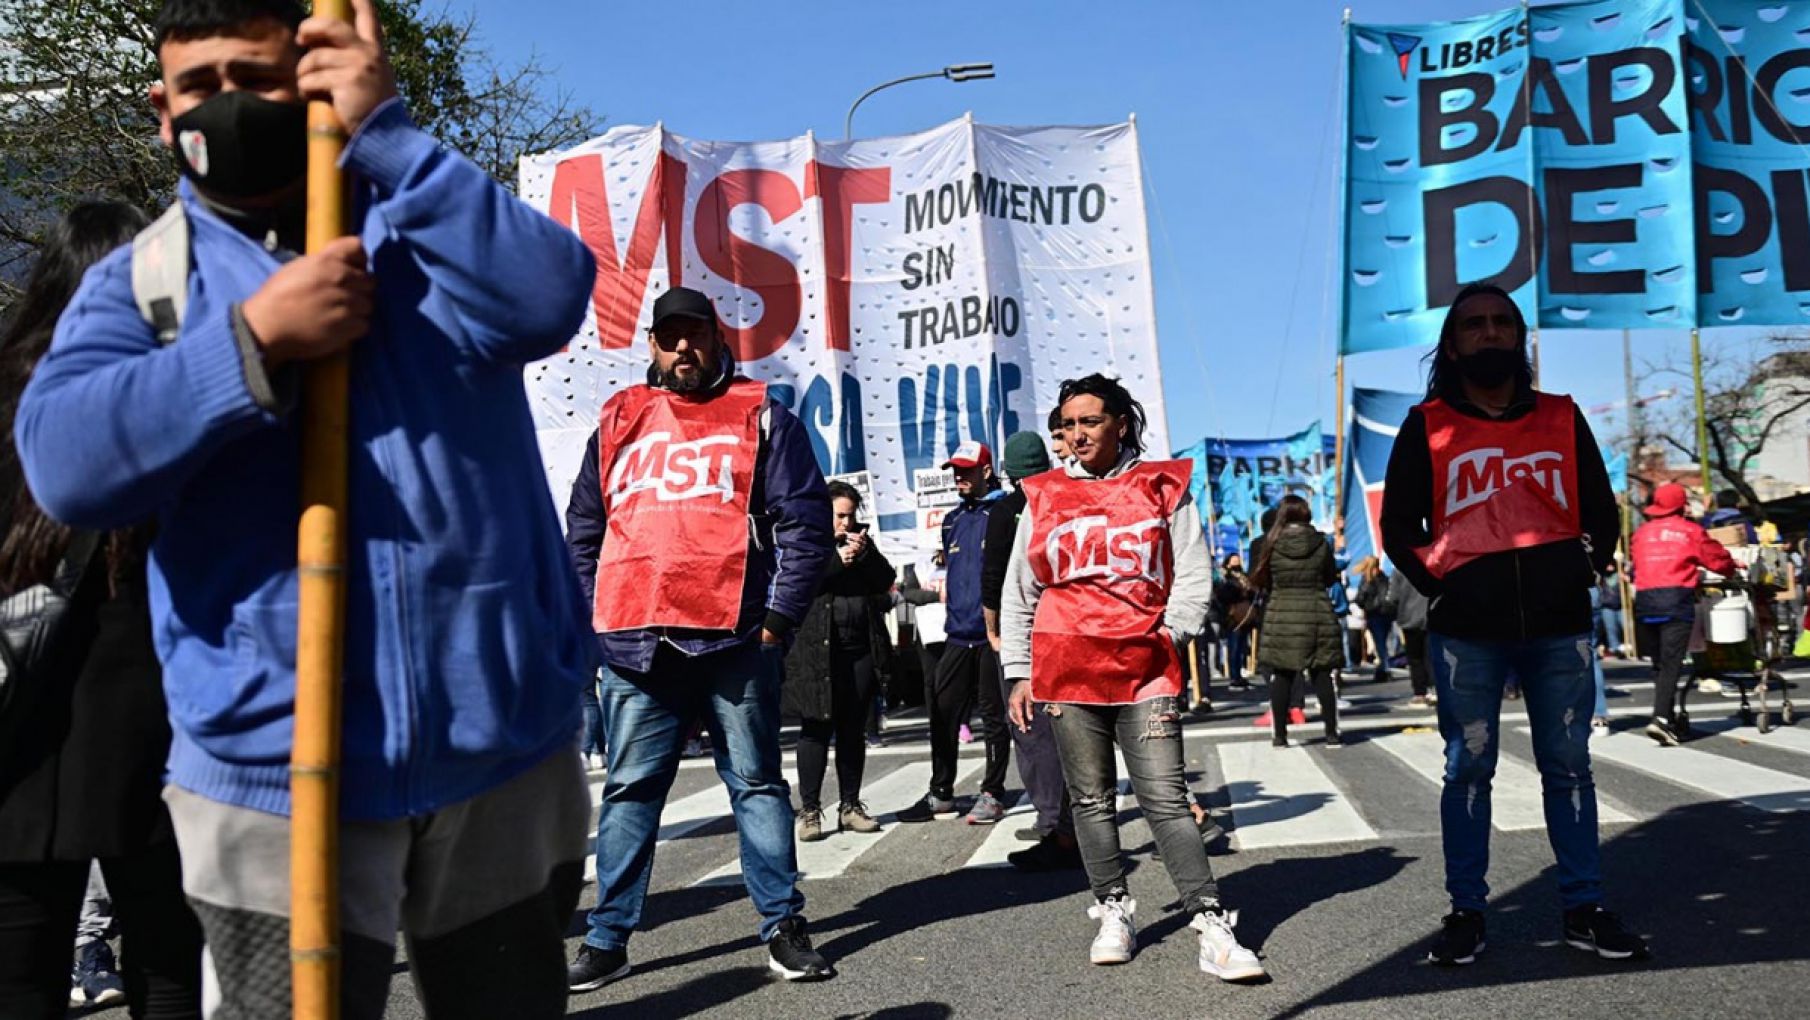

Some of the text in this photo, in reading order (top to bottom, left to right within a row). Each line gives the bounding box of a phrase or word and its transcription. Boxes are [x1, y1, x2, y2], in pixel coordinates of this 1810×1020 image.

[904, 171, 1106, 234] MOVMIENTO
[548, 150, 891, 362] MST
[900, 243, 955, 290] SIN
[1422, 161, 1810, 310] DE PI
[614, 438, 736, 498] MST
[1054, 521, 1167, 584] MST
